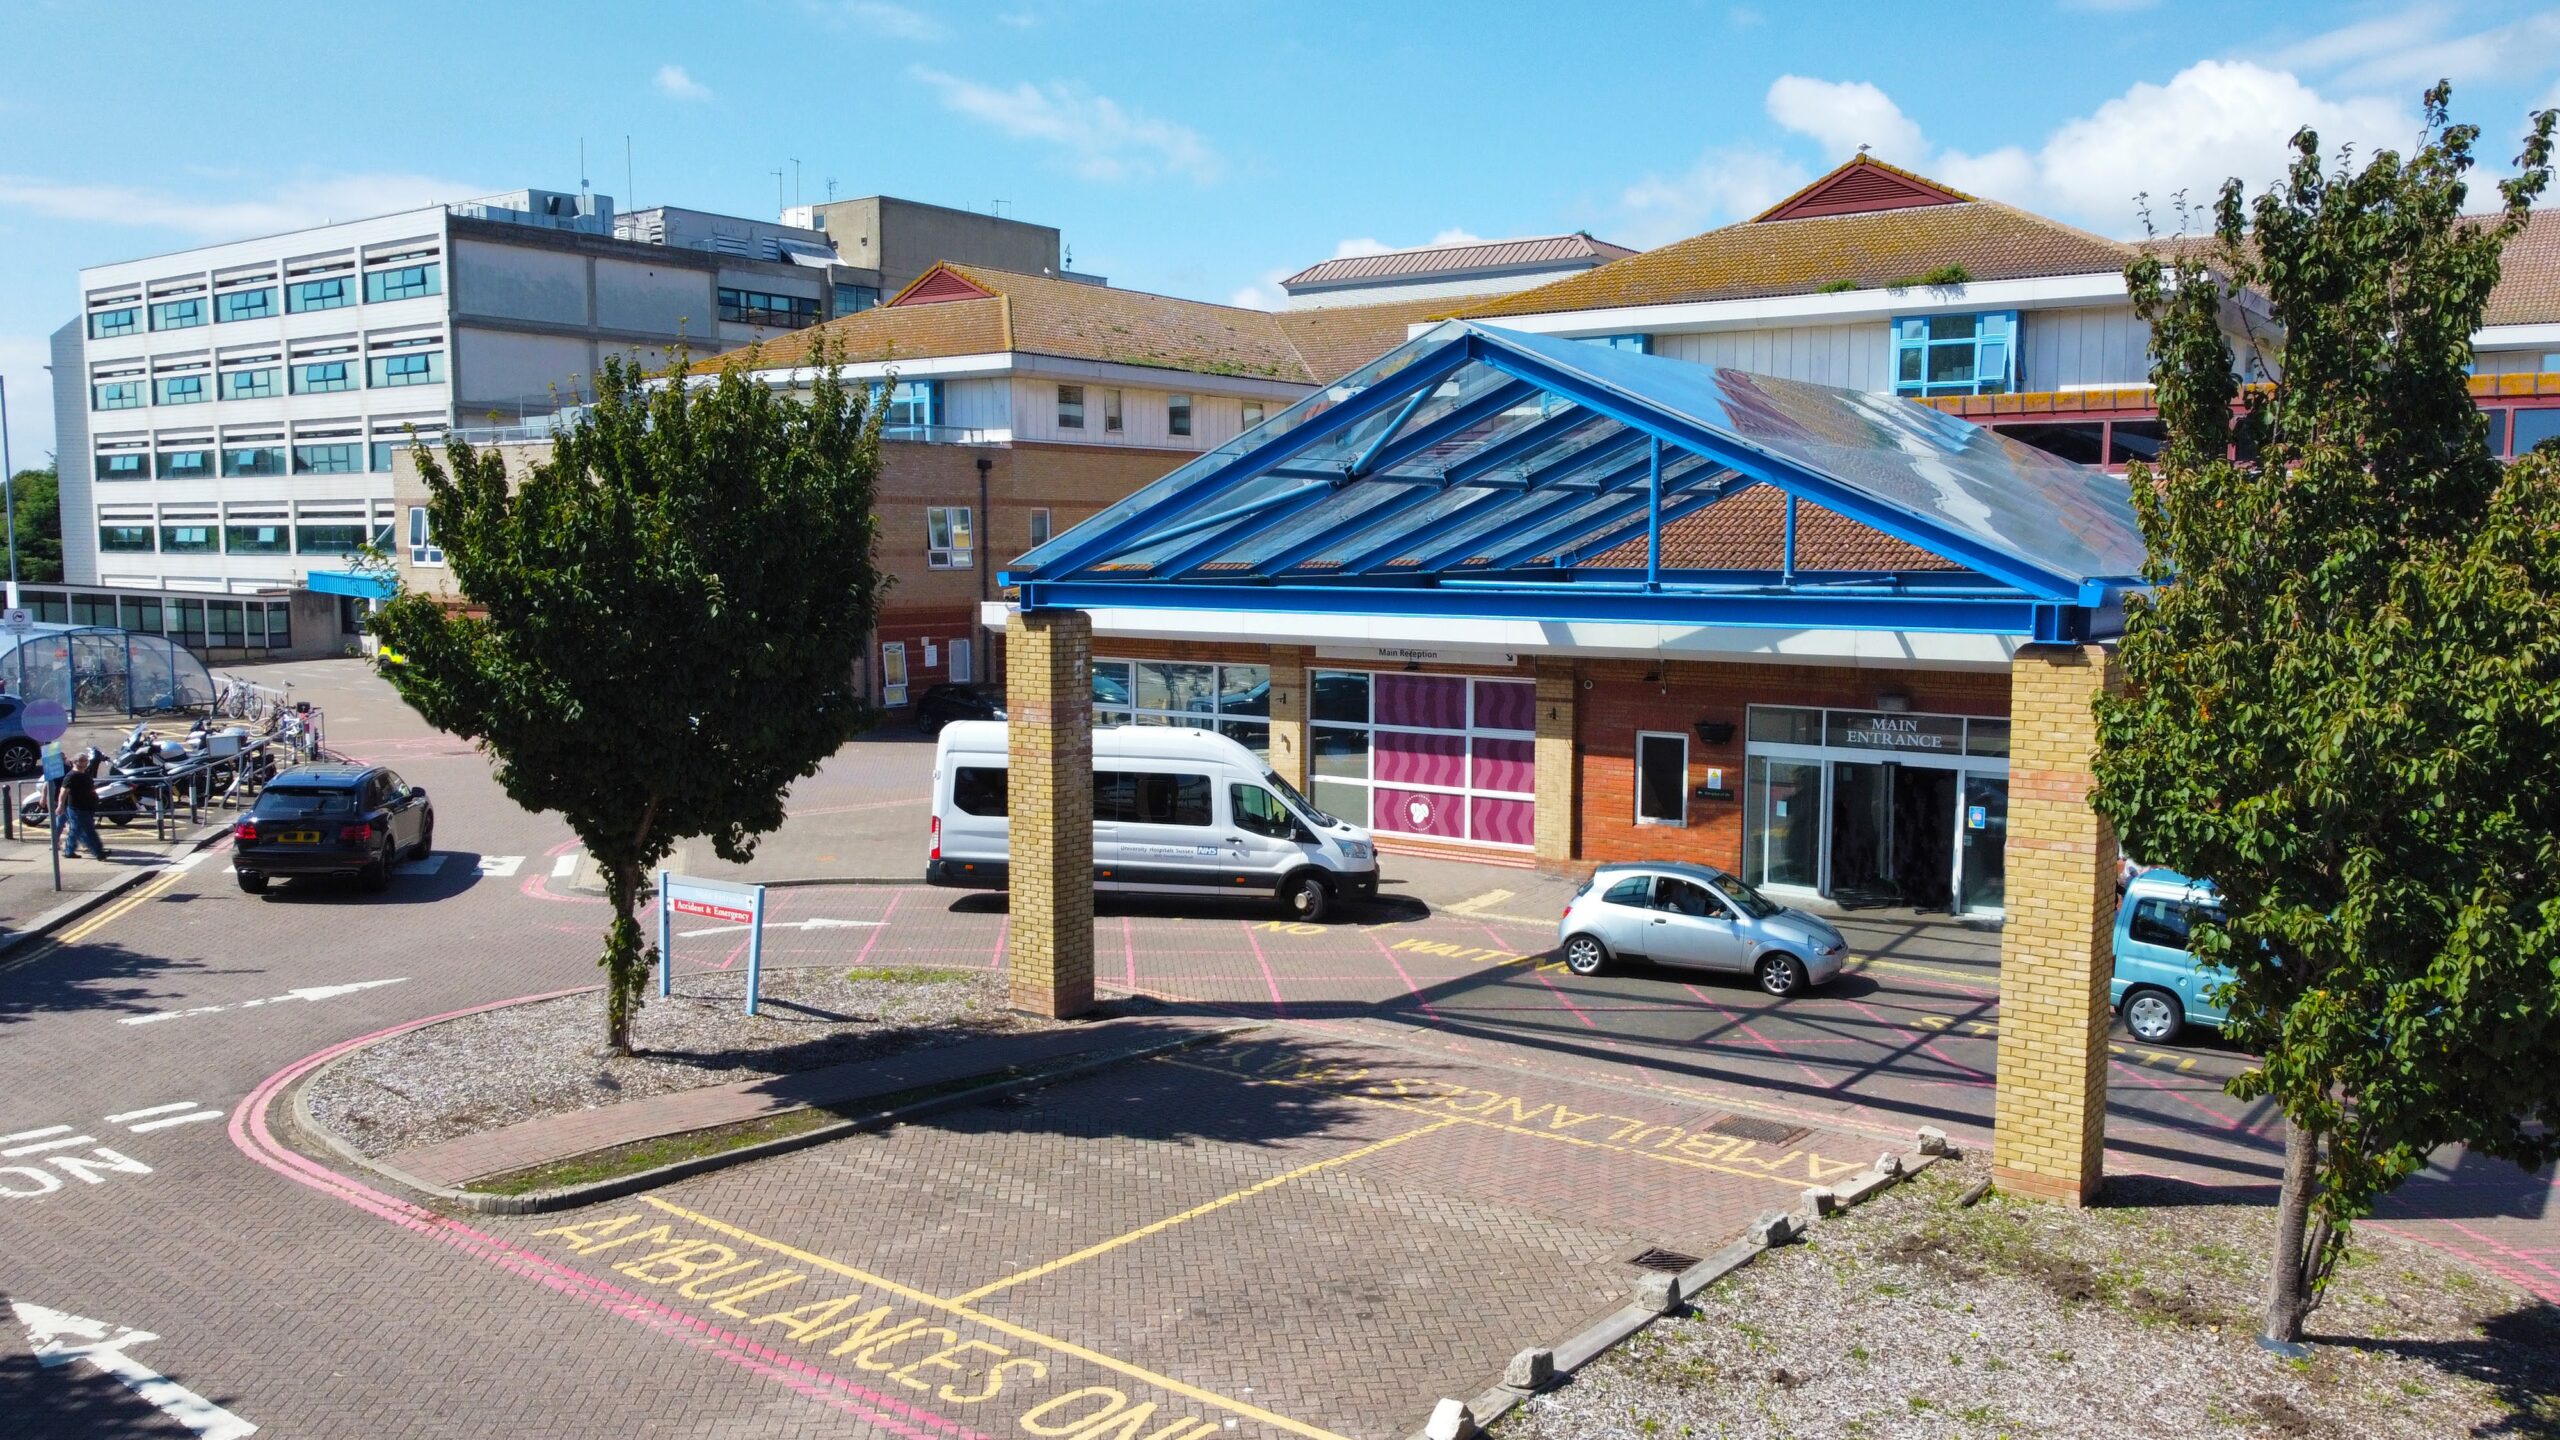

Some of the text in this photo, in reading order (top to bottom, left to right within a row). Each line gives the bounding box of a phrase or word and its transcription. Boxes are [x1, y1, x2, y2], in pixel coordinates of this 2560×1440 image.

[1379, 648, 1438, 659] Main Reception
[1871, 718, 1918, 732] MAIN
[1847, 730, 1942, 748] ENTRANCE
[1197, 847, 1217, 855] NHS
[677, 900, 750, 922] Accident & Emergency
[1251, 921, 1328, 934] NO
[531, 1214, 1047, 1403] AMBULANCES
